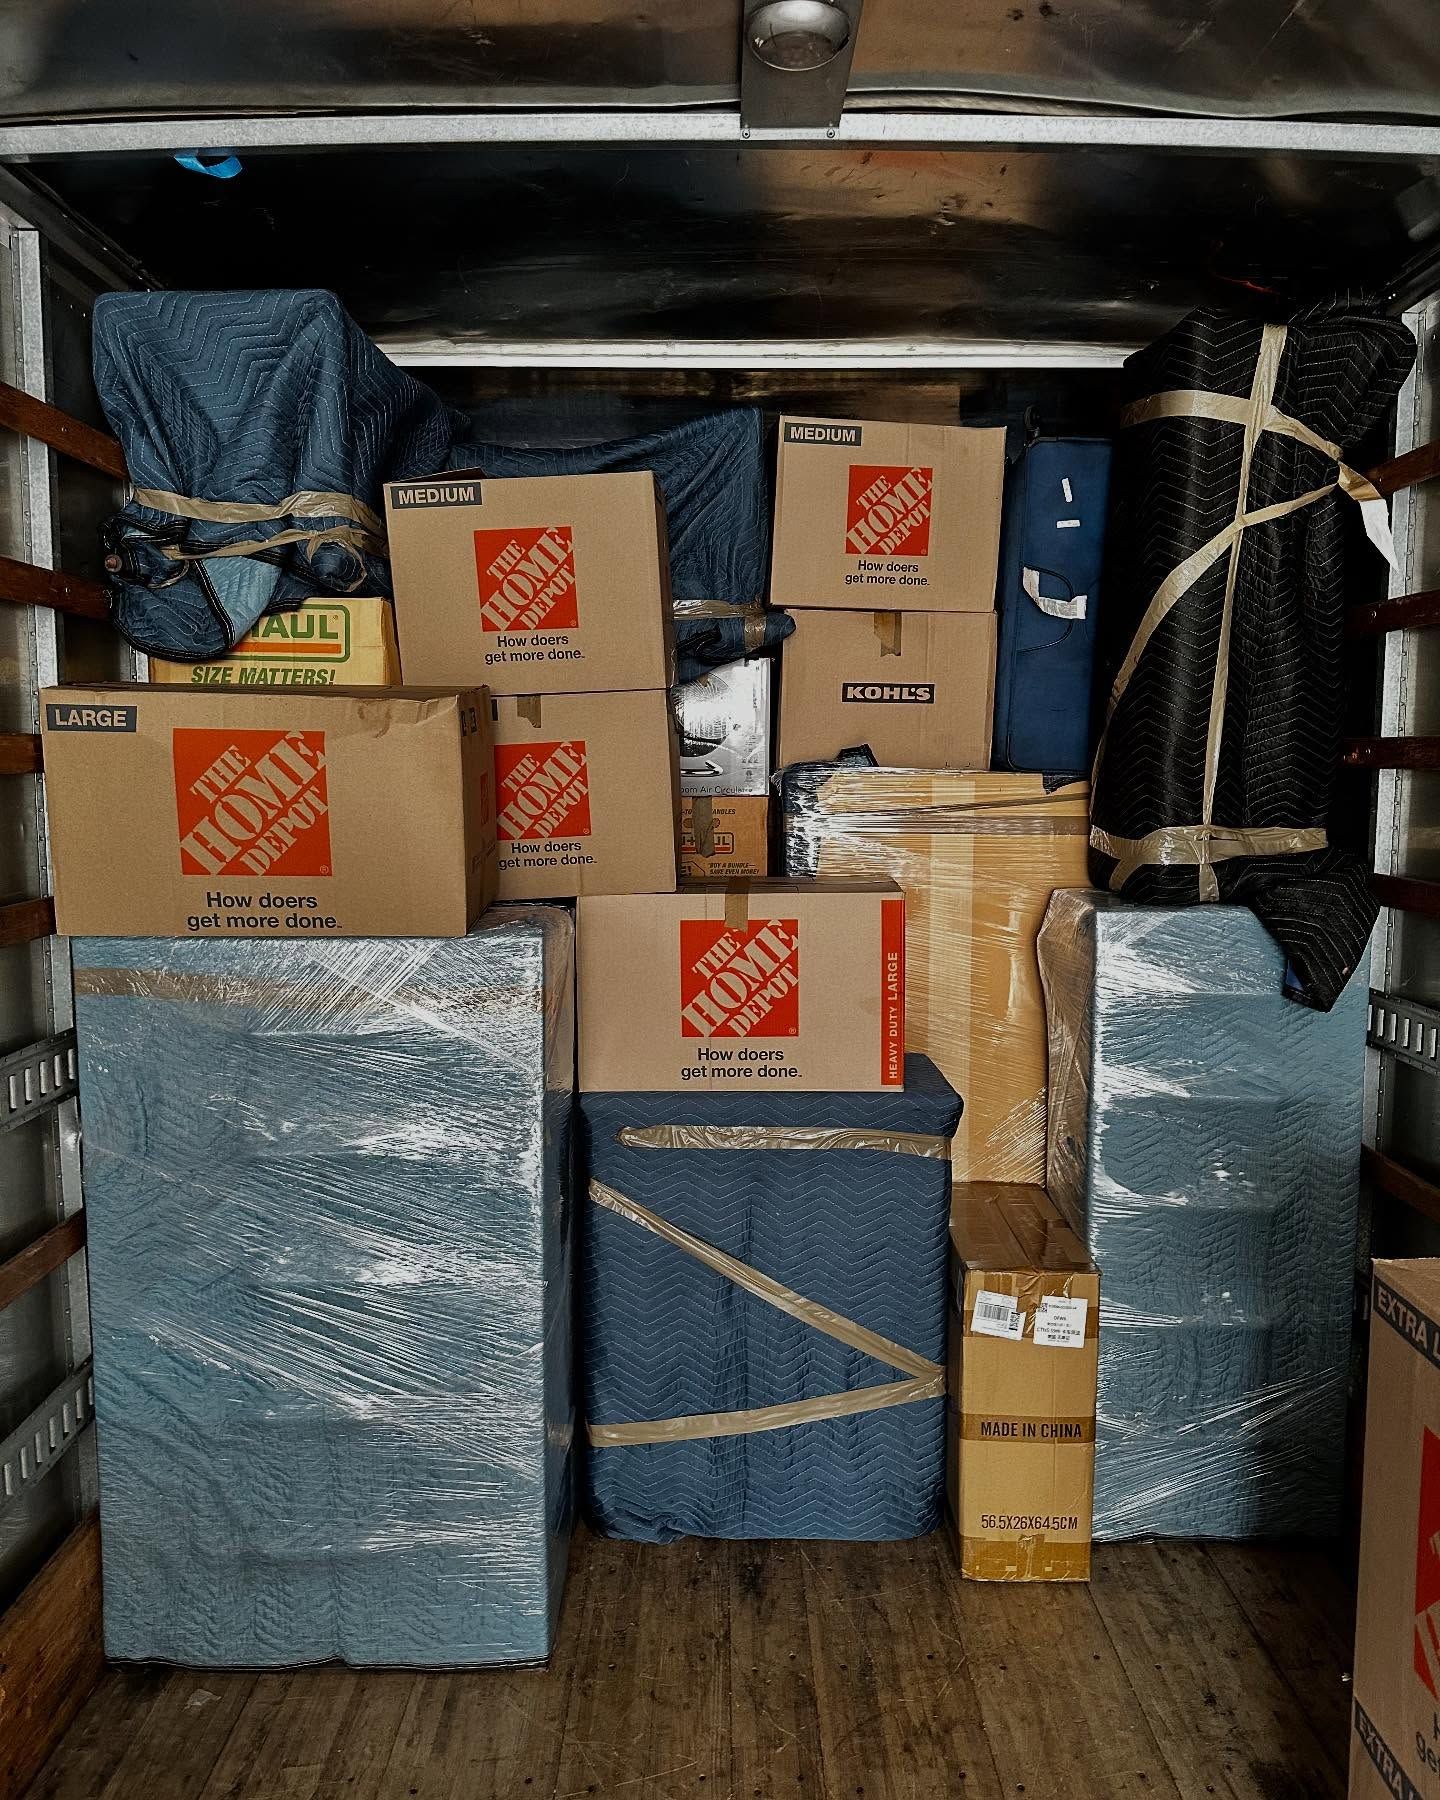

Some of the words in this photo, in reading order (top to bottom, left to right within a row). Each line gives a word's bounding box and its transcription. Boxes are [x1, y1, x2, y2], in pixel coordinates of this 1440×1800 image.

[790, 426, 856, 442] MEDIUM
[398, 486, 475, 505] MEDIUM
[856, 475, 892, 510] THE
[846, 467, 933, 554] HOME
[878, 500, 930, 555] DEPOT
[486, 539, 526, 580] THE
[857, 559, 884, 572] How
[886, 561, 919, 573] doers
[481, 527, 573, 631] HOME
[845, 573, 864, 585] get
[866, 574, 897, 584] more
[519, 564, 575, 630] DEPOT
[497, 635, 527, 648] How
[530, 634, 569, 647] doers
[484, 652, 506, 665] get
[510, 651, 545, 662] more
[191, 666, 233, 685] SIZE
[238, 667, 336, 686] MATTERS!
[846, 686, 931, 701] KOHL'S
[55, 709, 127, 727] LARGE
[189, 744, 251, 803] THE
[501, 753, 540, 793] THE
[180, 730, 327, 876] HOME
[496, 741, 588, 840] HOME
[701, 786, 712, 794] Air
[533, 776, 589, 838] DEPOT
[239, 786, 329, 876] DEPOT
[498, 857, 521, 870] get
[524, 856, 558, 867] more
[511, 842, 540, 854] How
[544, 841, 582, 853] doers
[206, 892, 252, 908] How
[259, 892, 317, 908] doers
[187, 914, 221, 931] get
[227, 916, 279, 928] more
[691, 928, 742, 980] THE
[681, 919, 800, 1037] HOME
[887, 952, 898, 1001] LARGE
[727, 963, 799, 1037] DEPOT
[888, 1007, 898, 1037] DUTY
[698, 1048, 733, 1061] How
[738, 1047, 784, 1061] doers
[889, 1040, 898, 1079] HEAVY
[681, 1066, 707, 1080] get
[712, 1067, 753, 1078] more
[1378, 1285, 1428, 1350] EXTRA
[981, 1421, 1018, 1437] MADE
[1022, 1423, 1036, 1437] IN
[1041, 1423, 1082, 1438] CHINA
[981, 1514, 1078, 1530] 56.5X26X64.5CM
[1360, 1710, 1403, 1800] EXTRA
